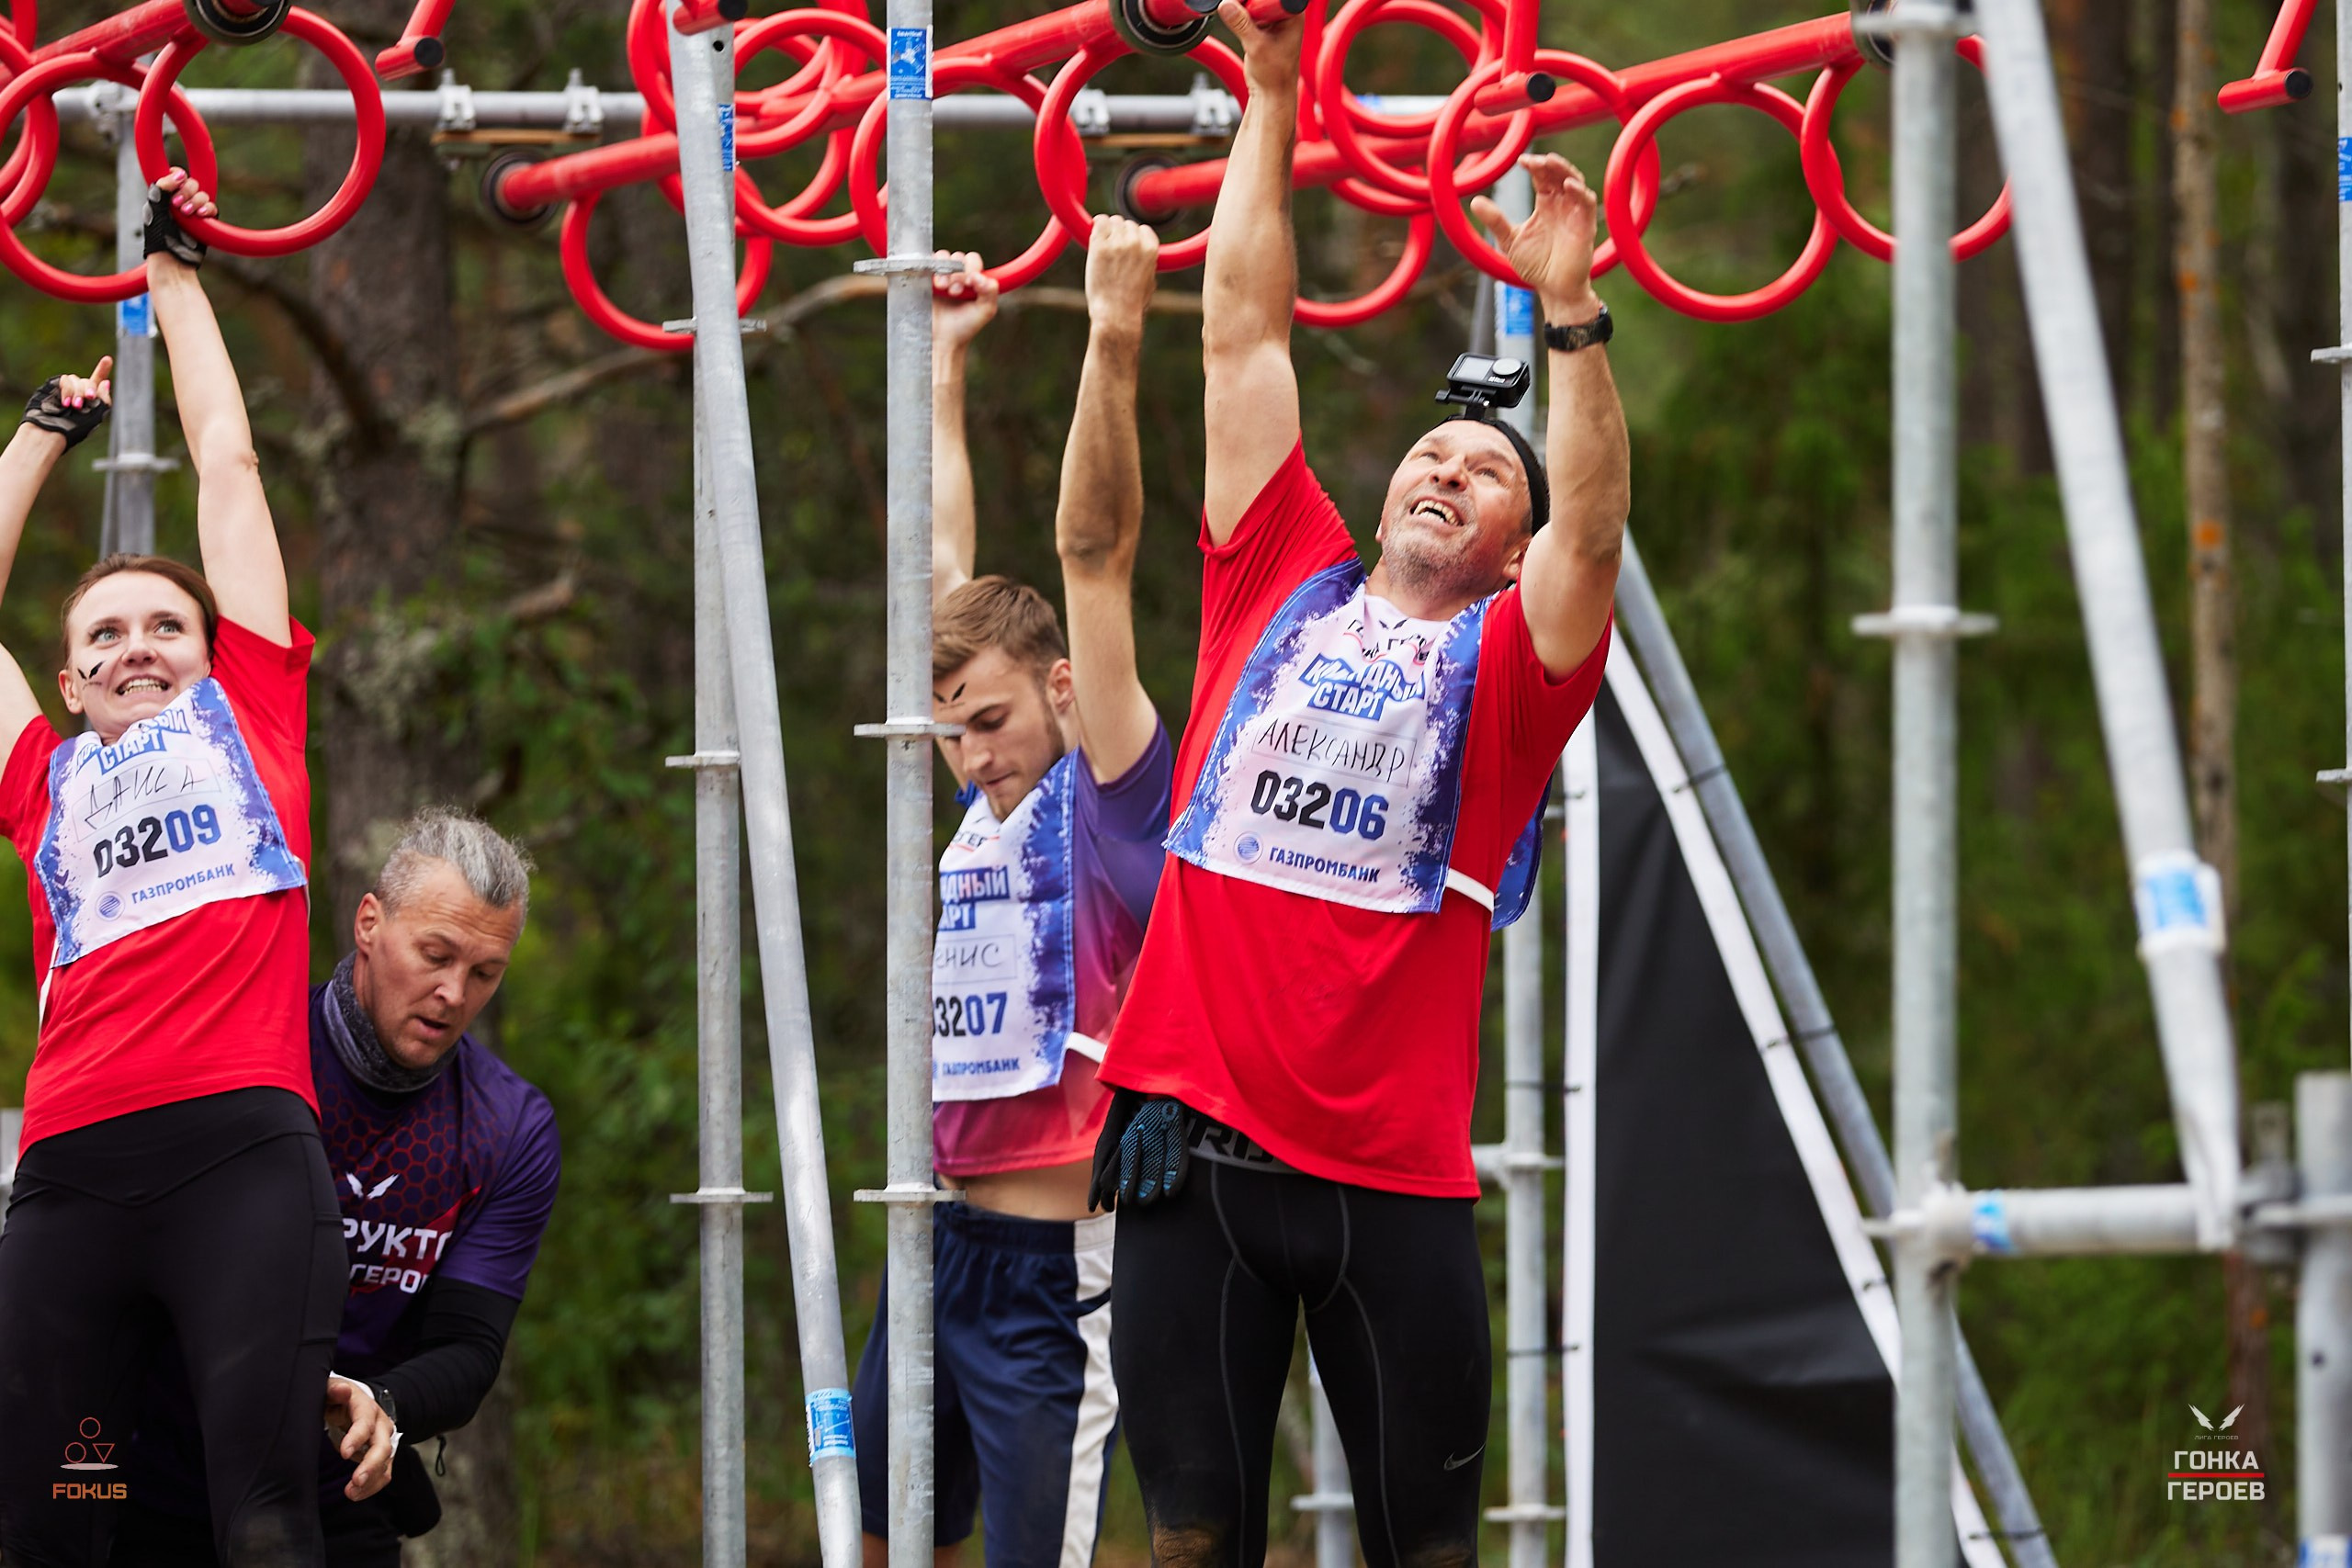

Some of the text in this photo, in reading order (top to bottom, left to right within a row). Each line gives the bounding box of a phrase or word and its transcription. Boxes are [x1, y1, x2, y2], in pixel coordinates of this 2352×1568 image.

[1312, 681, 1384, 718] СТАРТ
[99, 728, 162, 772] СТАРТ
[1257, 717, 1406, 783] АЛЕКСАНДР
[1250, 769, 1389, 841] 03206
[93, 804, 221, 878] 03209
[131, 863, 235, 904] ГАЗПРОМБАНК
[1269, 847, 1381, 883] ГАЗПРОМБАНК
[933, 992, 1007, 1037] 3207
